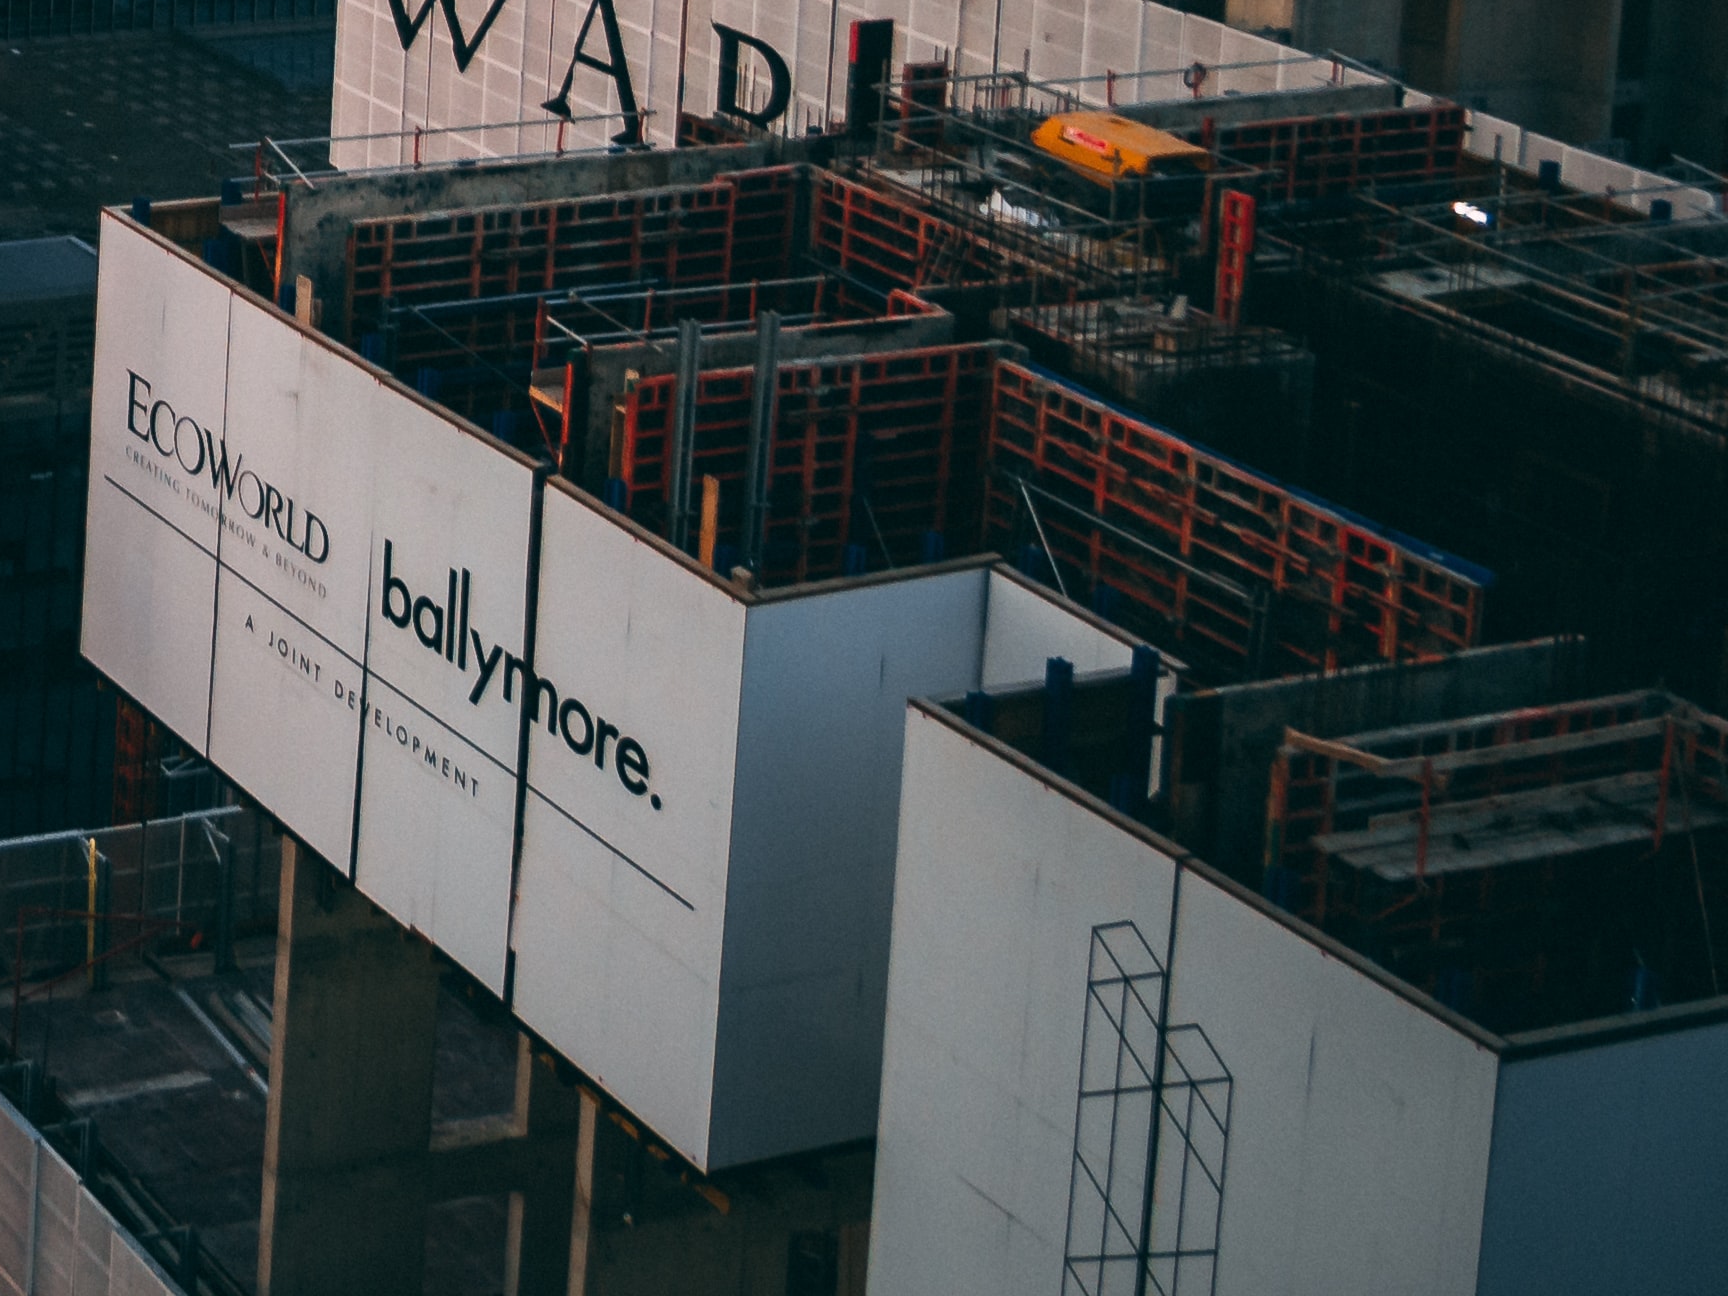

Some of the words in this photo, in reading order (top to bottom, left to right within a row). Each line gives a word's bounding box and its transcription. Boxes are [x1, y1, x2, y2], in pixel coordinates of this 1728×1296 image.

[124, 445, 181, 494] CREATING
[275, 554, 327, 599] BEYOND
[126, 368, 330, 564] ECOWORLD
[244, 614, 255, 633] A
[268, 630, 321, 682] JOINT
[334, 679, 480, 798] DEVELOPMENT
[381, 537, 664, 812] ballymore.
